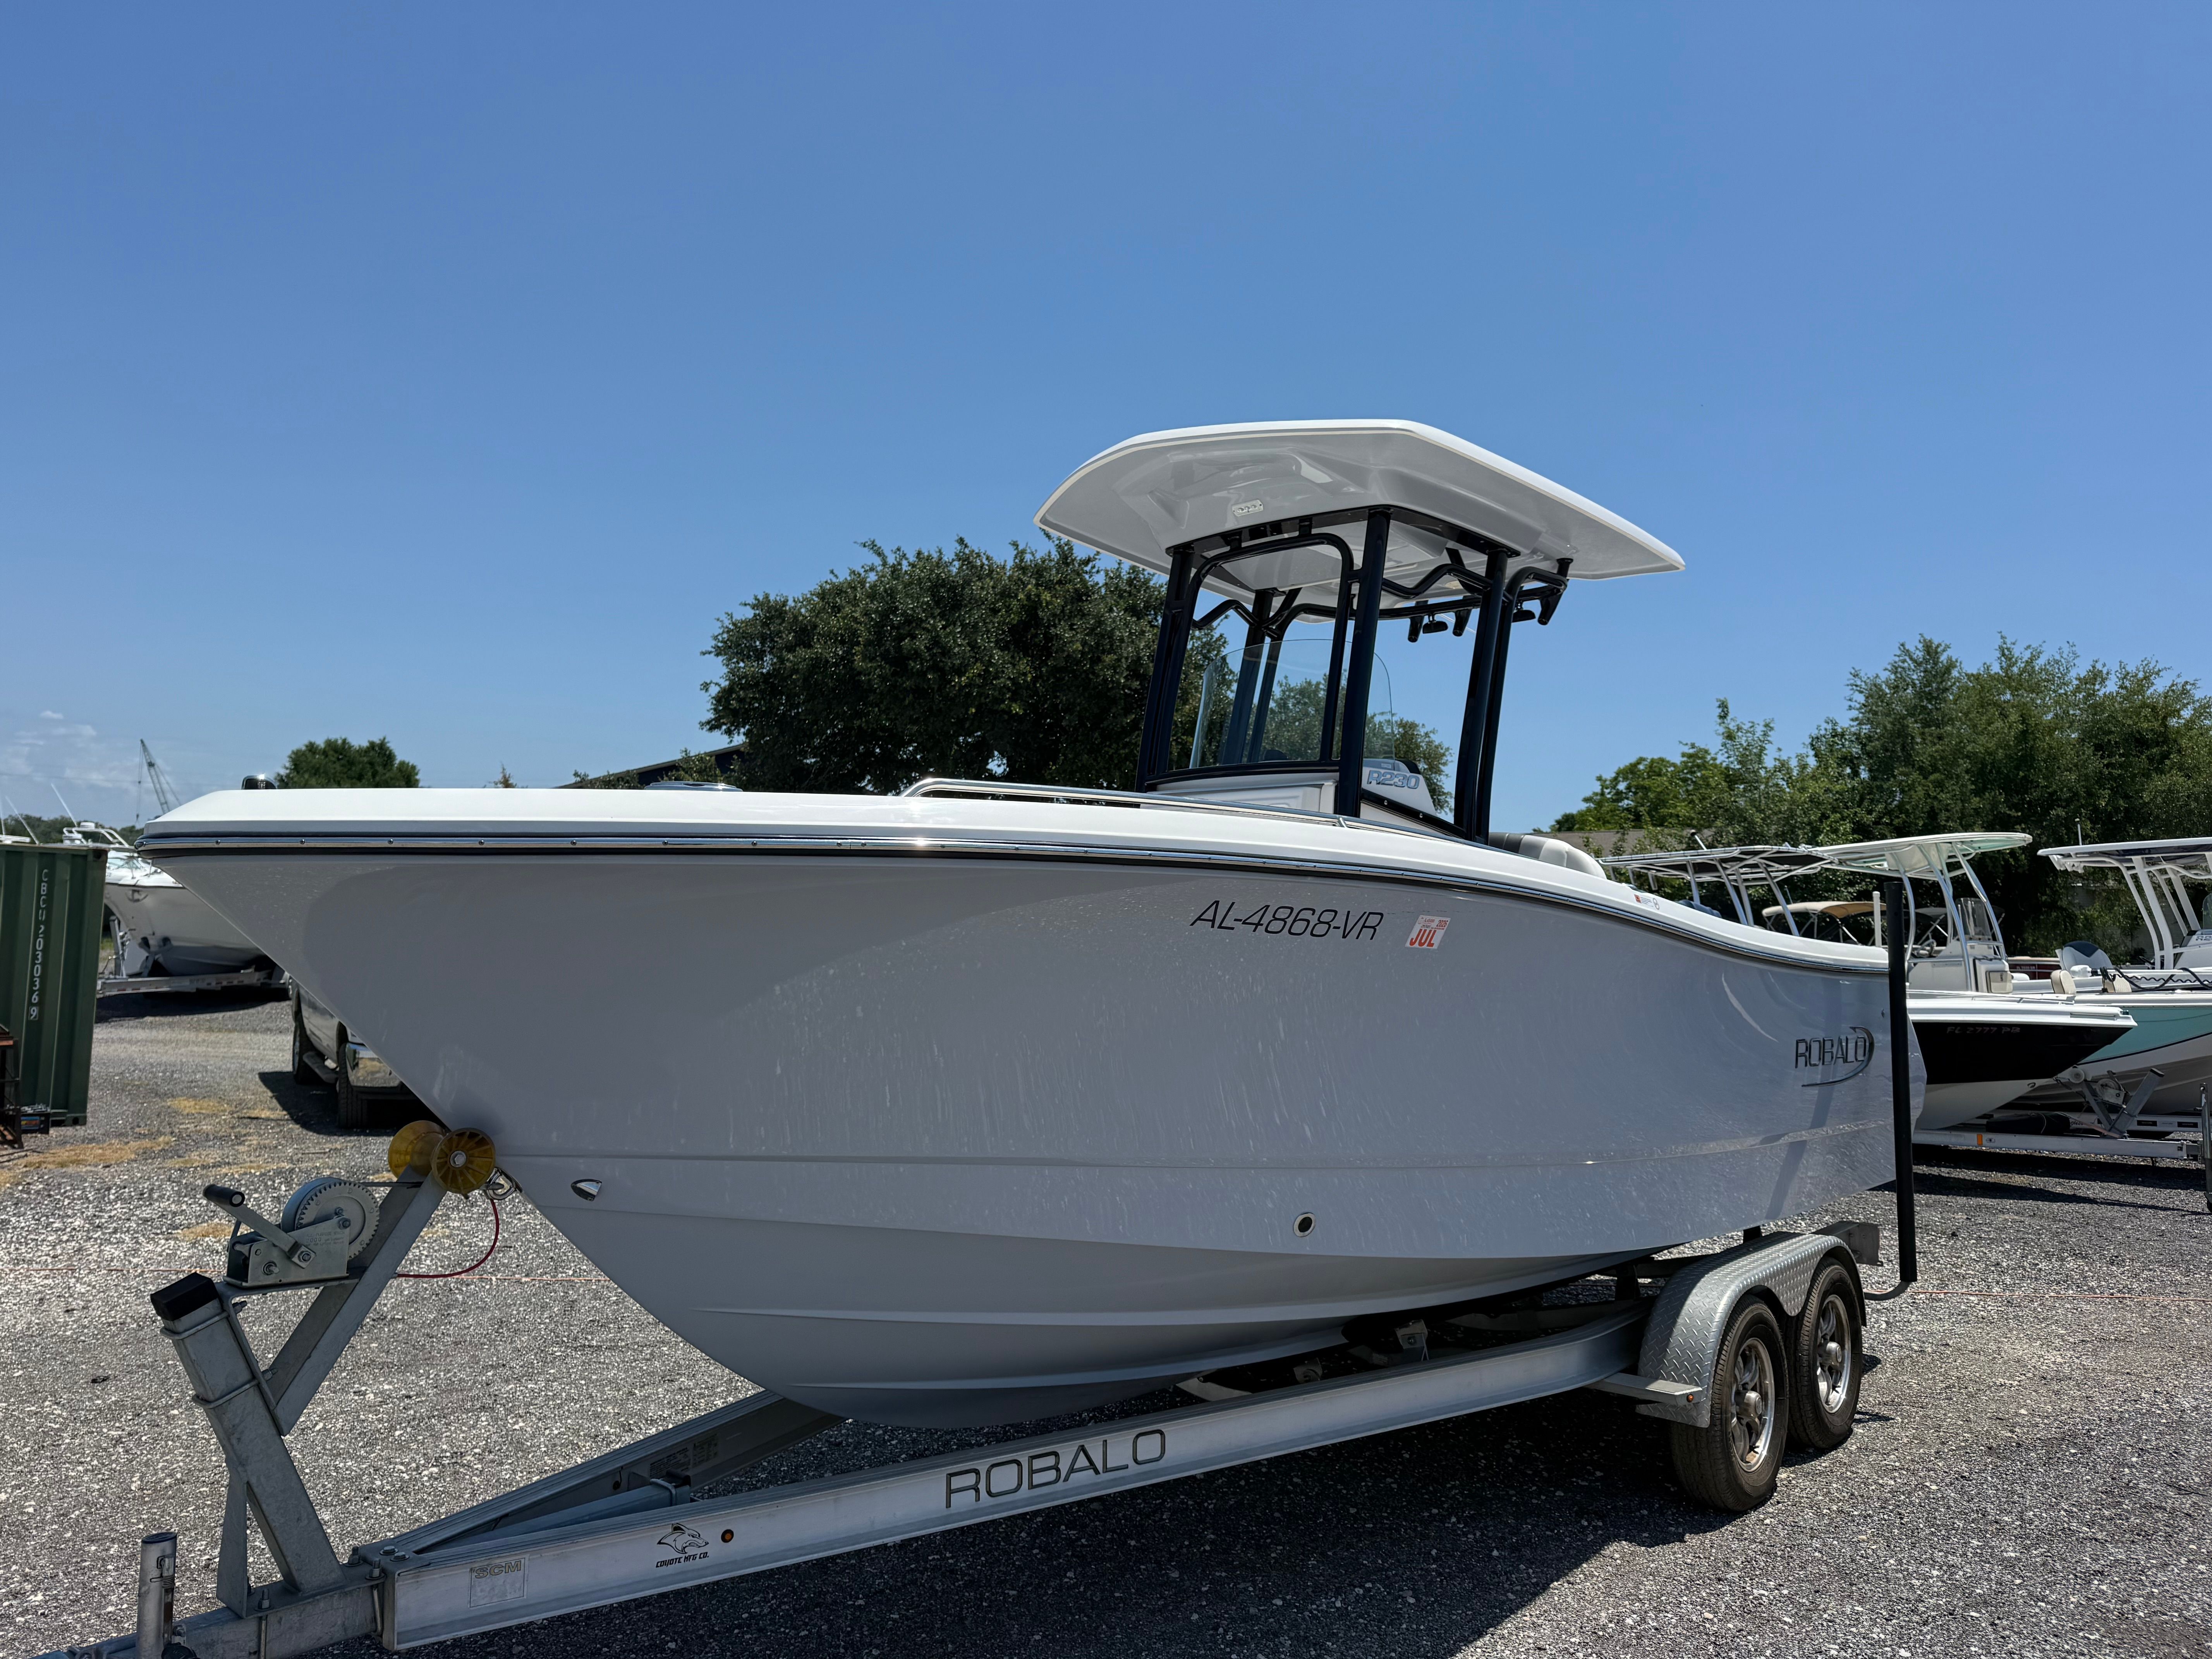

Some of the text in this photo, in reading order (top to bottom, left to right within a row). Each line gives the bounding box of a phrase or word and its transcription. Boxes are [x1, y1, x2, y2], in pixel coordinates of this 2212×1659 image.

[1367, 769, 1420, 789] R230
[1189, 900, 1384, 940] AL-4868-VR
[1409, 928, 1437, 947] JUL
[1795, 1035, 1867, 1069] ROBALO
[946, 1429, 1166, 1508] ROBALO
[475, 1560, 522, 1579] SCM
[656, 1551, 709, 1568] COYOTE MFG CO.
